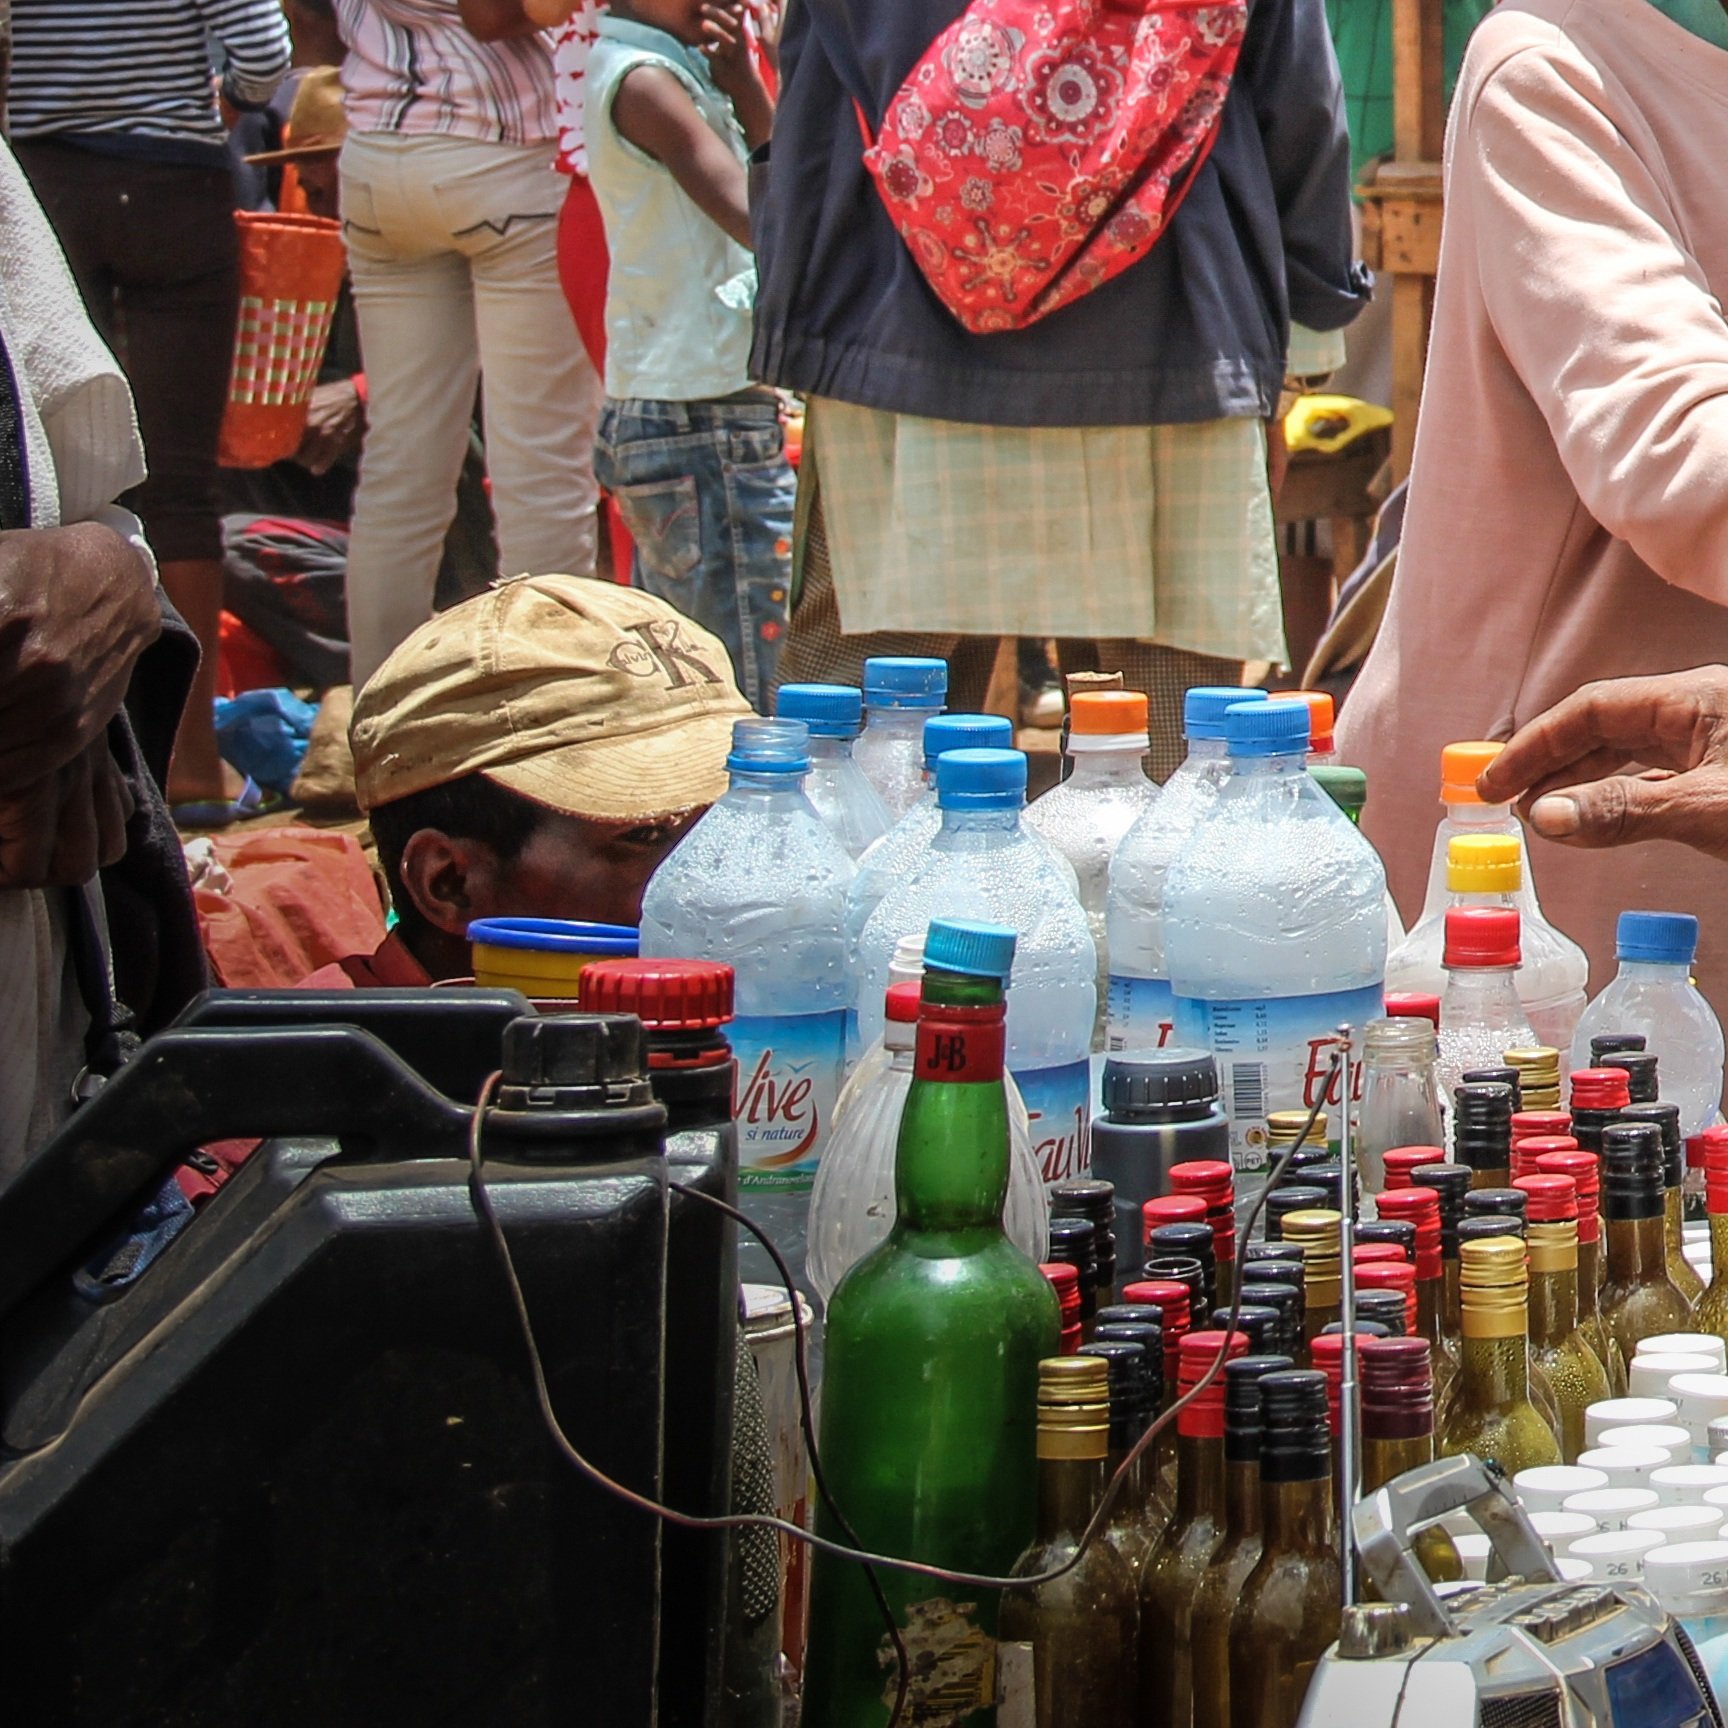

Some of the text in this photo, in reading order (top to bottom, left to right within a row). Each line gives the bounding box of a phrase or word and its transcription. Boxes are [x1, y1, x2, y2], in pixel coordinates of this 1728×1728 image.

[927, 1033, 967, 1072] J&B
[731, 1048, 812, 1125] Vive
[745, 1125, 806, 1141] si nature
[1606, 1562, 1628, 1576] 26
[1701, 1571, 1722, 1585] 26
